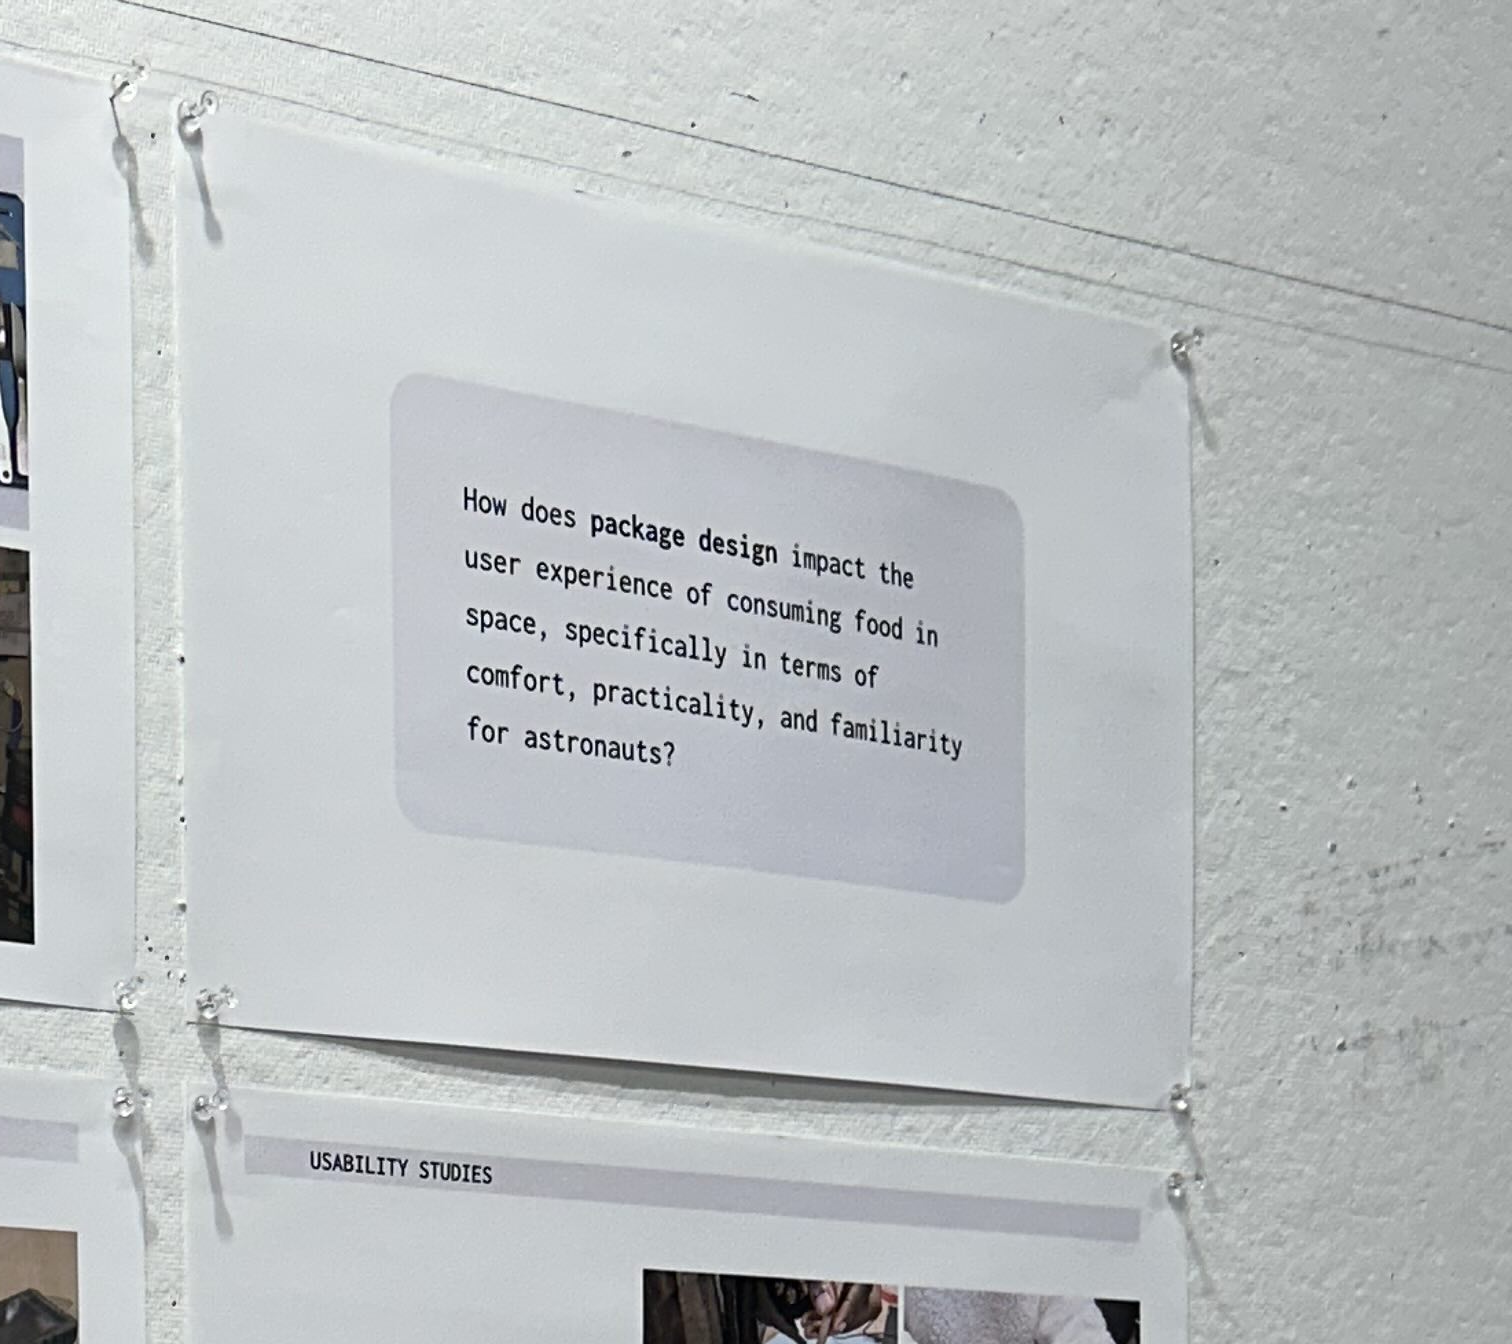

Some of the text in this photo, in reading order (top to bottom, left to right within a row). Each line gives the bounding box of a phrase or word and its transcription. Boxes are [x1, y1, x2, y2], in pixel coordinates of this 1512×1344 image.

[463, 486, 914, 590] How does package design impact the
[465, 549, 938, 648] user experience of consuming food in
[466, 607, 880, 689] space, specifically in terms of
[467, 664, 962, 762] comfort, practicality, and familiarity
[467, 715, 675, 767] for astronauts?
[310, 1150, 493, 1185] USABILITY STUDIES
